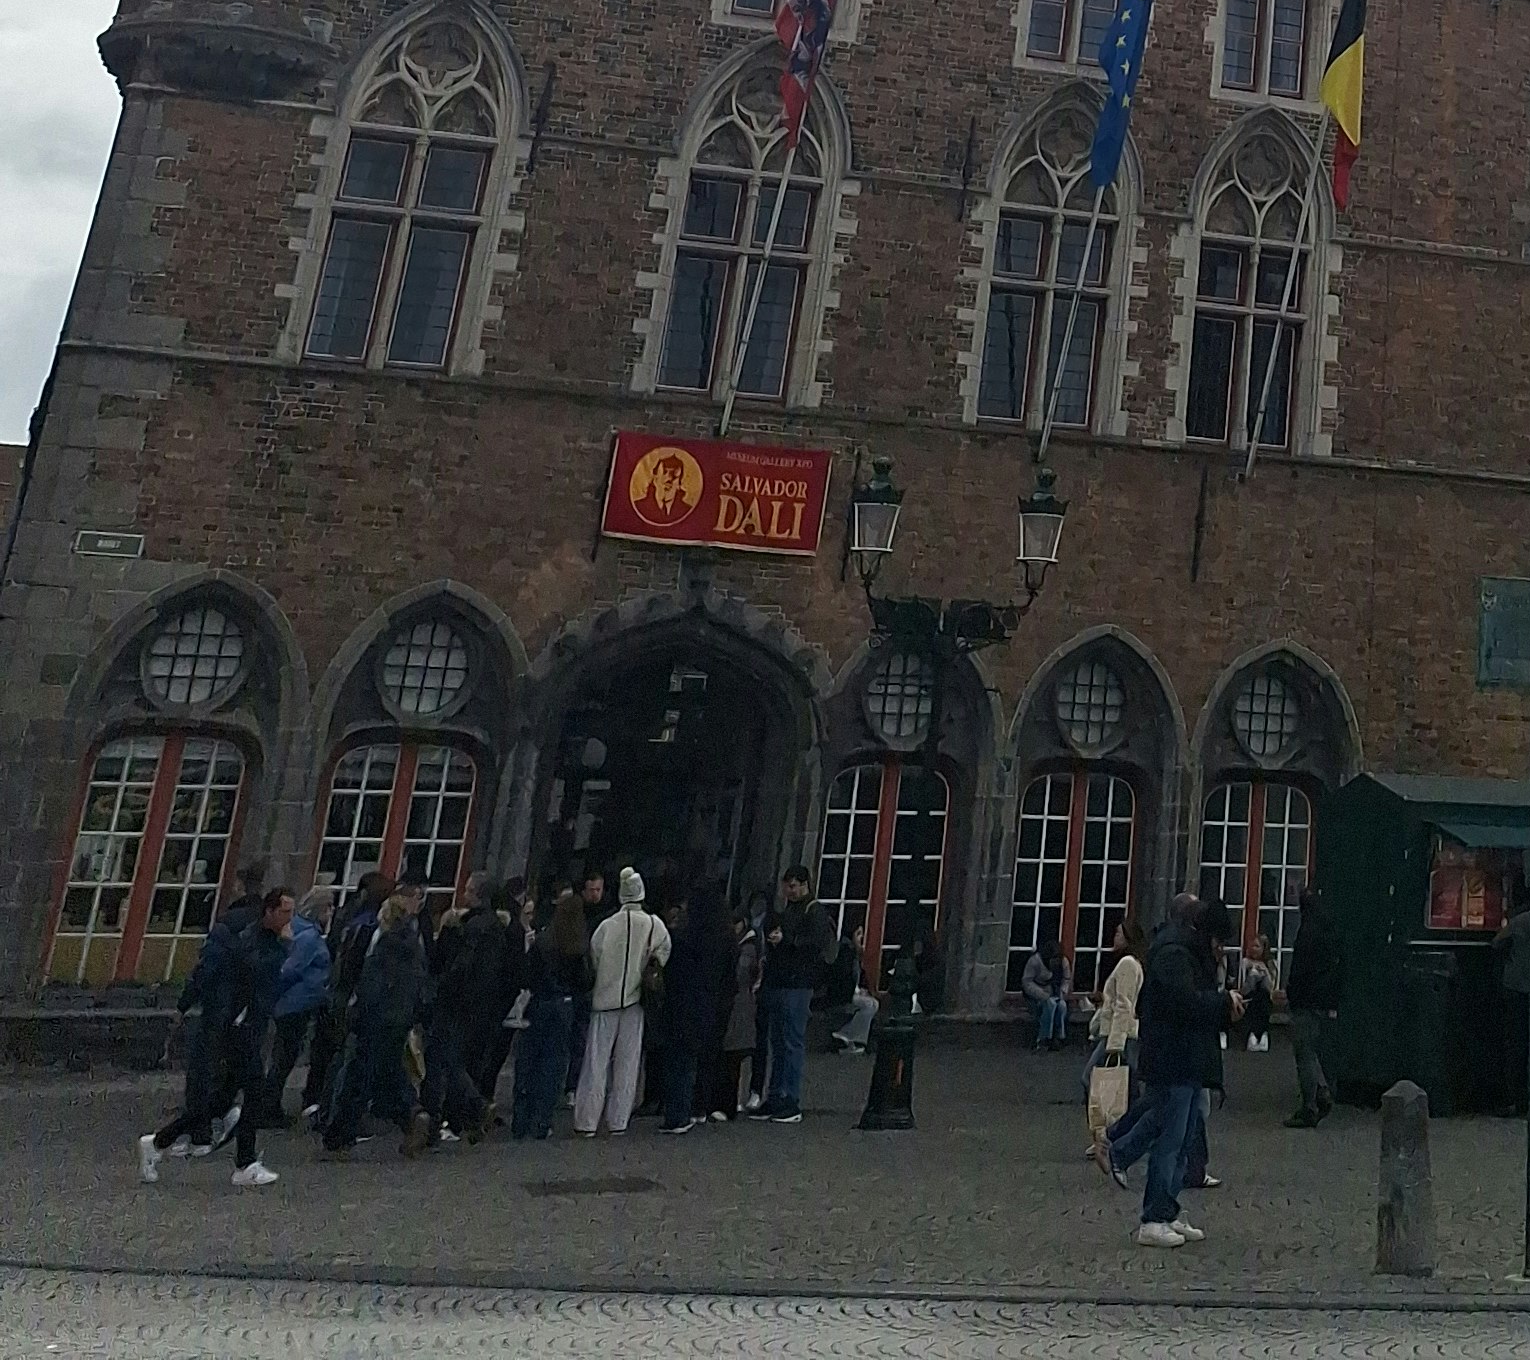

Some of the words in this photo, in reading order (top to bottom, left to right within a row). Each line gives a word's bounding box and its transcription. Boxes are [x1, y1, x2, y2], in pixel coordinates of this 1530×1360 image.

[760, 455, 796, 467] GALLERY
[720, 472, 808, 499] SALVADOR
[713, 494, 806, 540] DALI
